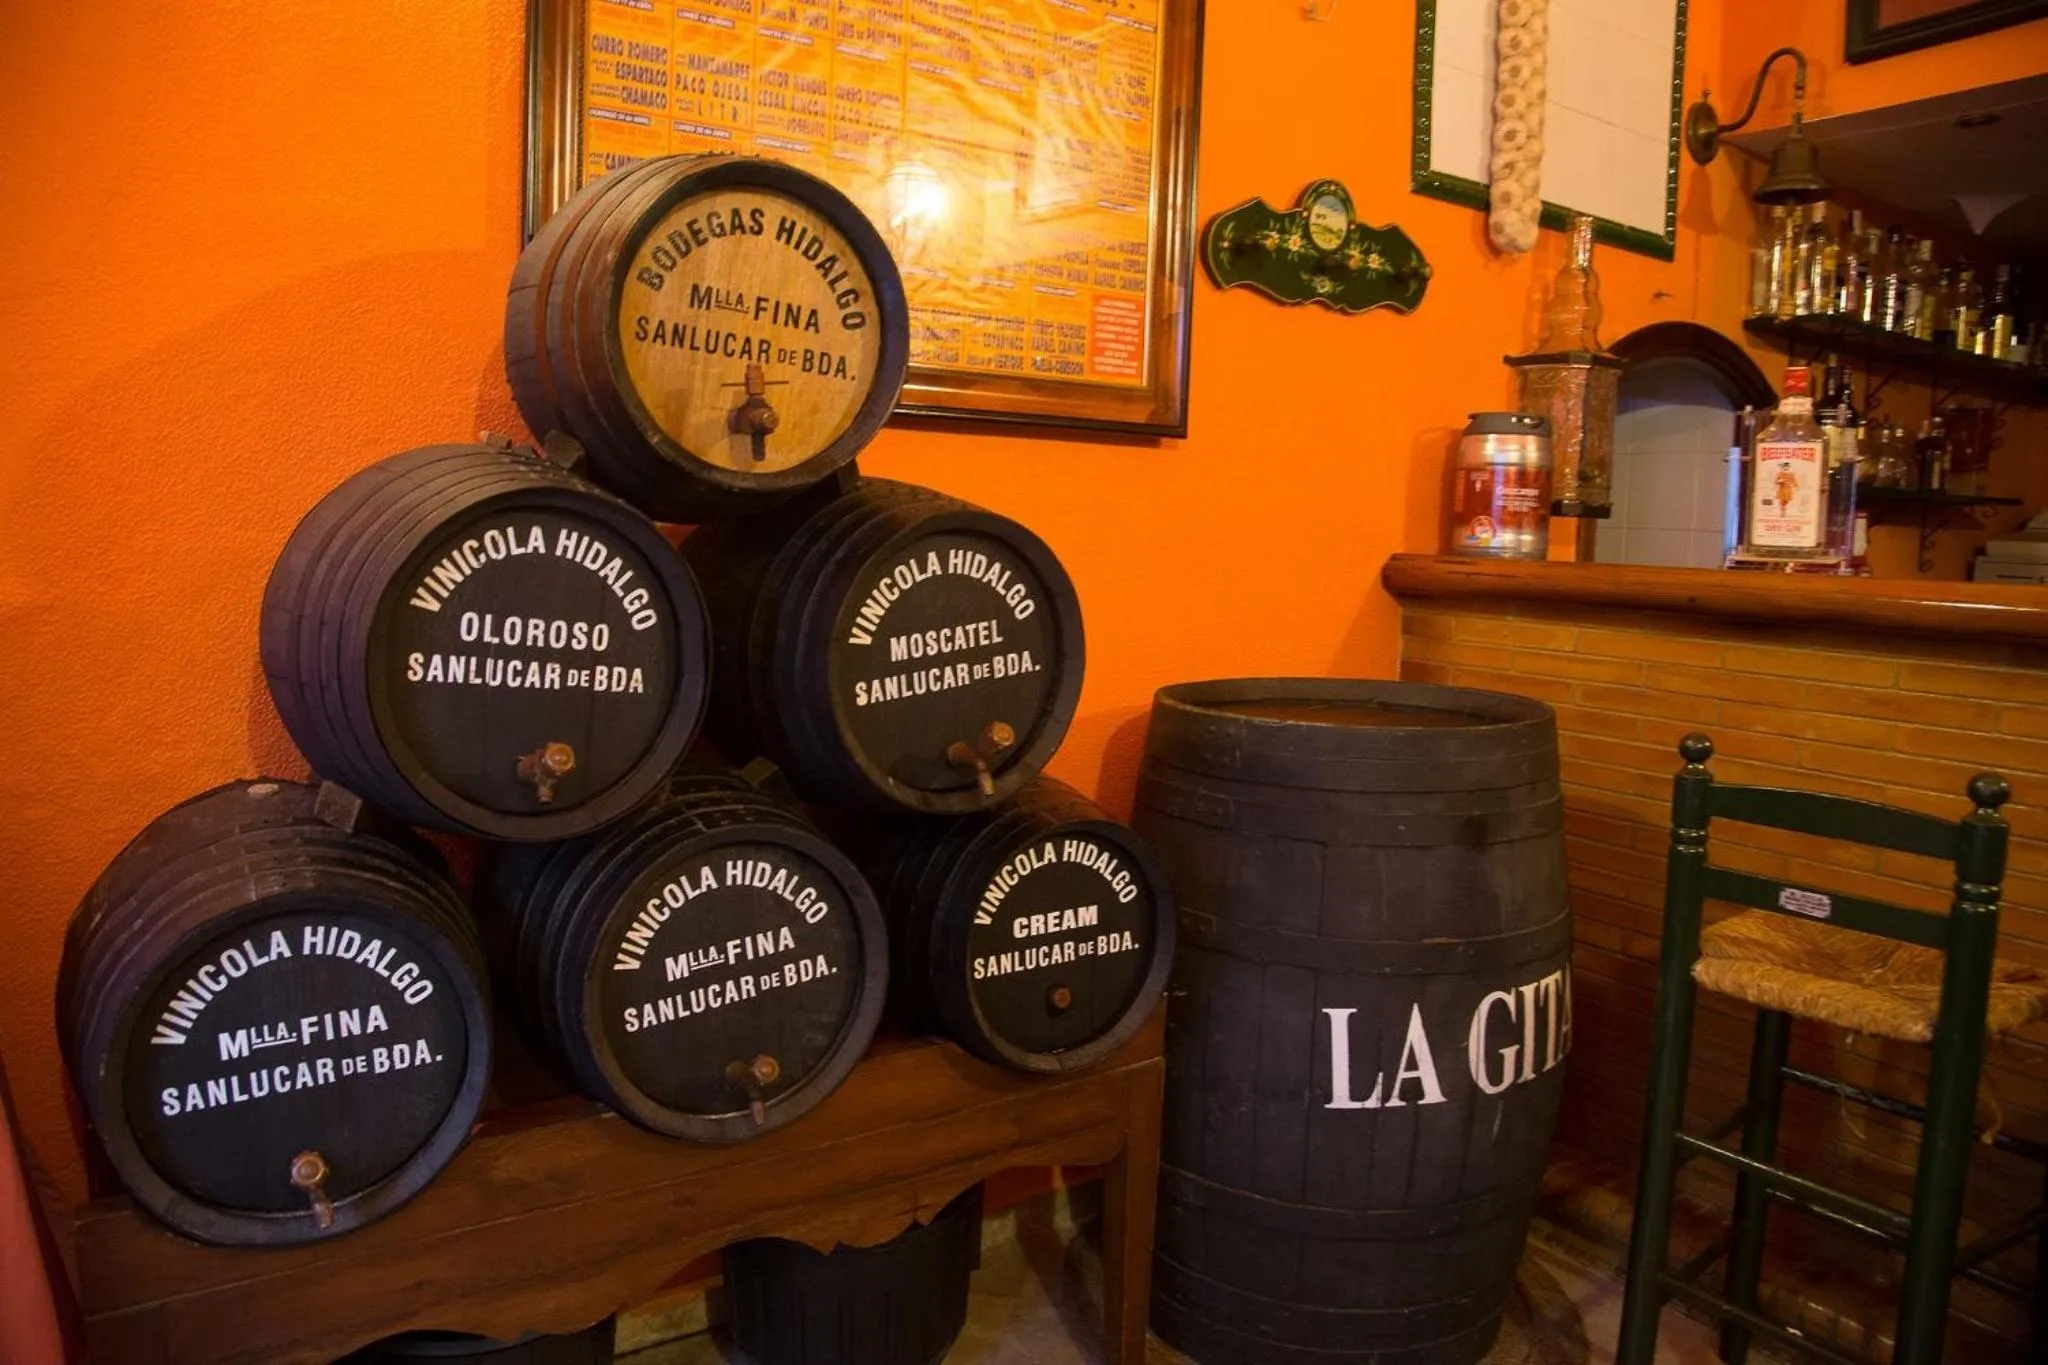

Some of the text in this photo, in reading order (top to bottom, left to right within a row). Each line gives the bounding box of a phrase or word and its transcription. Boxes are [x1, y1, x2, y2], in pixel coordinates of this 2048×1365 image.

[592, 34, 624, 56] CURRO
[628, 41, 668, 65] ROMERO
[615, 61, 668, 88] ESPARTACO
[621, 86, 667, 109] CHAMACO
[676, 74, 705, 95] PACO
[637, 208, 866, 331] BODEGAS HIDALGO
[753, 296, 820, 334] FINA
[635, 316, 857, 381] SANLUCAR DE BDA.
[409, 525, 658, 631] VINICOLA HIDALGO
[848, 549, 1036, 645] VINICOLA HIDALGO
[460, 611, 610, 652] OLOROSO
[889, 619, 1004, 662] MOSCATEL
[407, 653, 644, 694] SANLUCAR DE BDA
[855, 650, 1041, 707] SANLUCAR DE BDA.
[974, 840, 1138, 925] VINICOLA HIDALGO
[613, 860, 829, 971] VINICOLA HIDALGO
[1013, 904, 1099, 939] CREAM
[726, 926, 795, 965] FINA
[974, 931, 1140, 980] SANLUCAR DE BDA.
[151, 925, 434, 1046] VINICOLA HIDALGO
[624, 954, 838, 1033] SANLUCAR DE BDA.
[300, 1004, 388, 1046] FINA
[161, 1038, 443, 1117] SANLUCAR DE BDA.
[1321, 1002, 1448, 1109] LA
